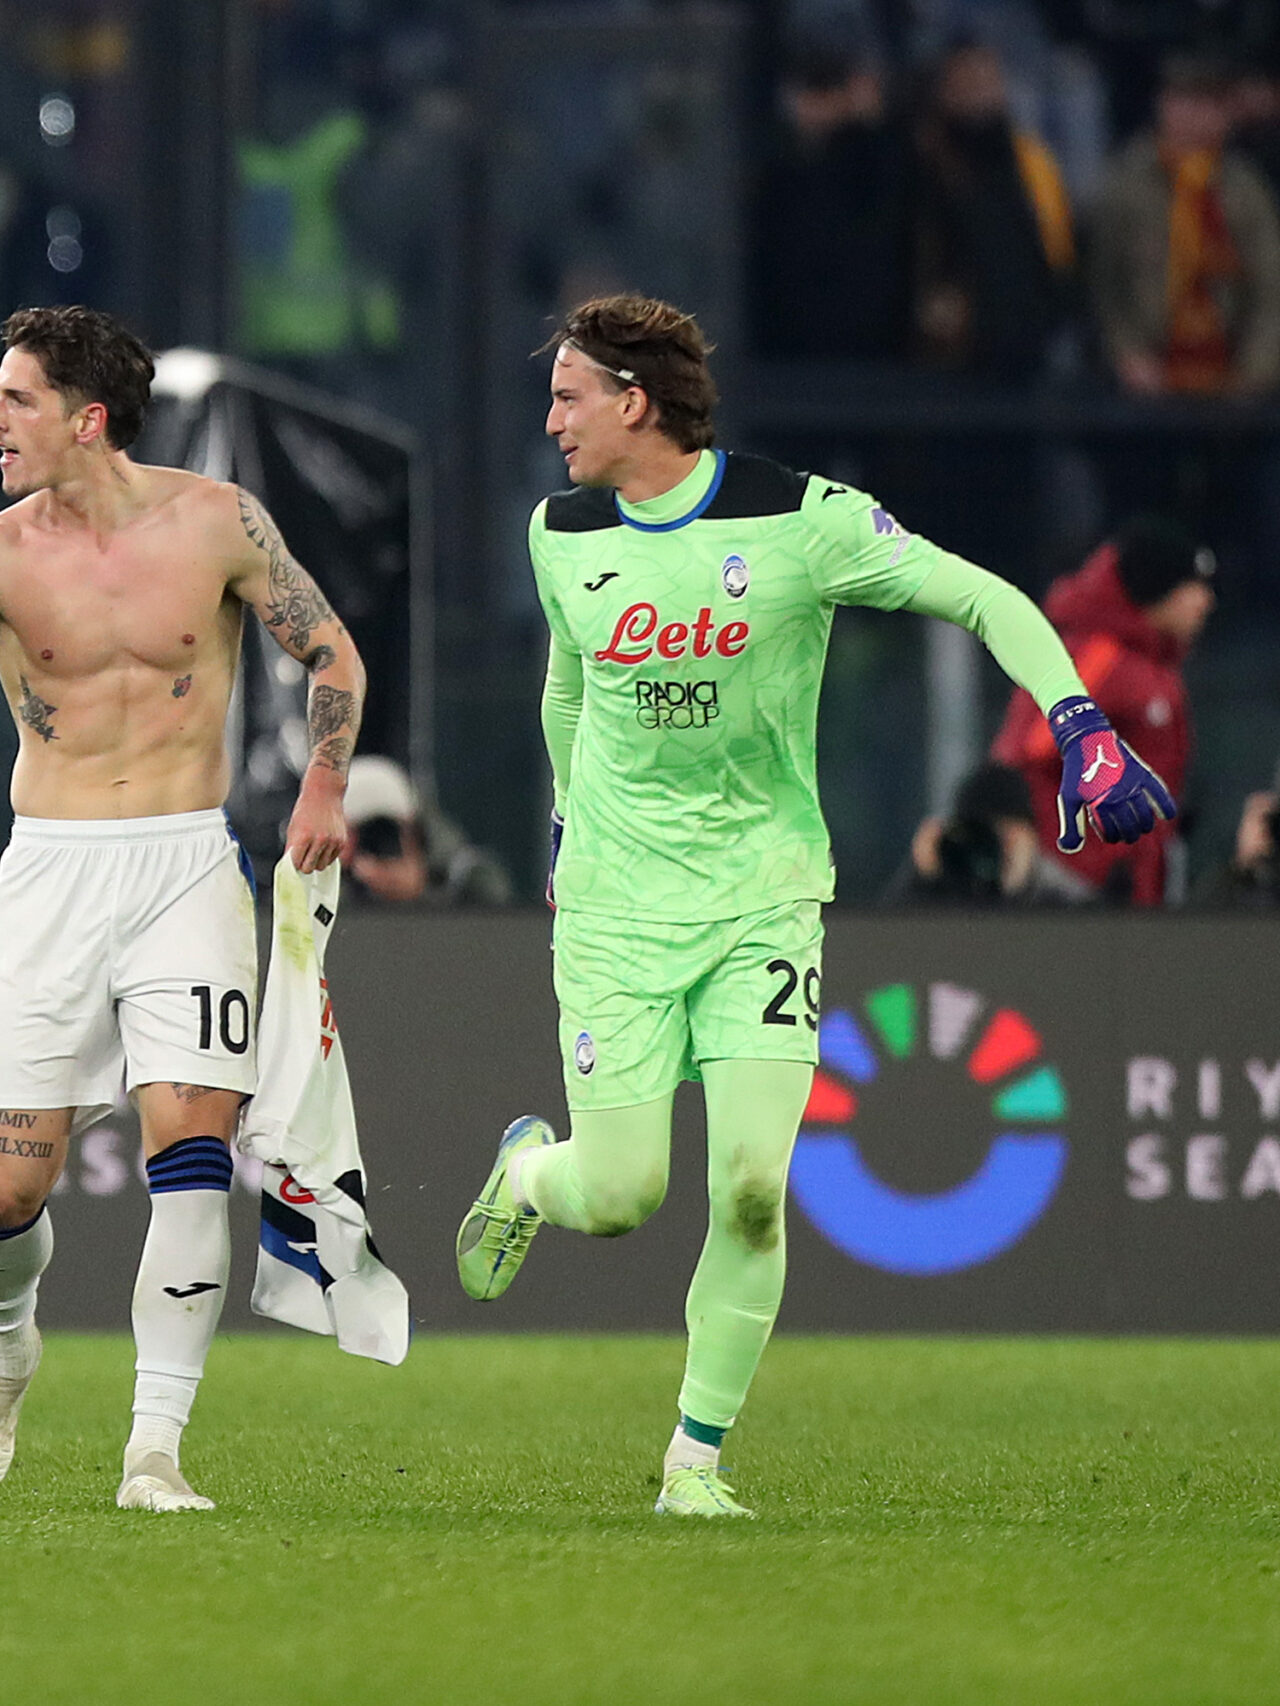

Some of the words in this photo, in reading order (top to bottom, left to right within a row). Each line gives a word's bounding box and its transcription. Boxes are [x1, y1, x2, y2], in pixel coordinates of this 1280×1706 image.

[594, 602, 749, 664] Lete
[635, 680, 718, 706] RADICI
[636, 706, 720, 729] GROUP
[190, 986, 249, 1055] 10
[762, 959, 820, 1032] 29
